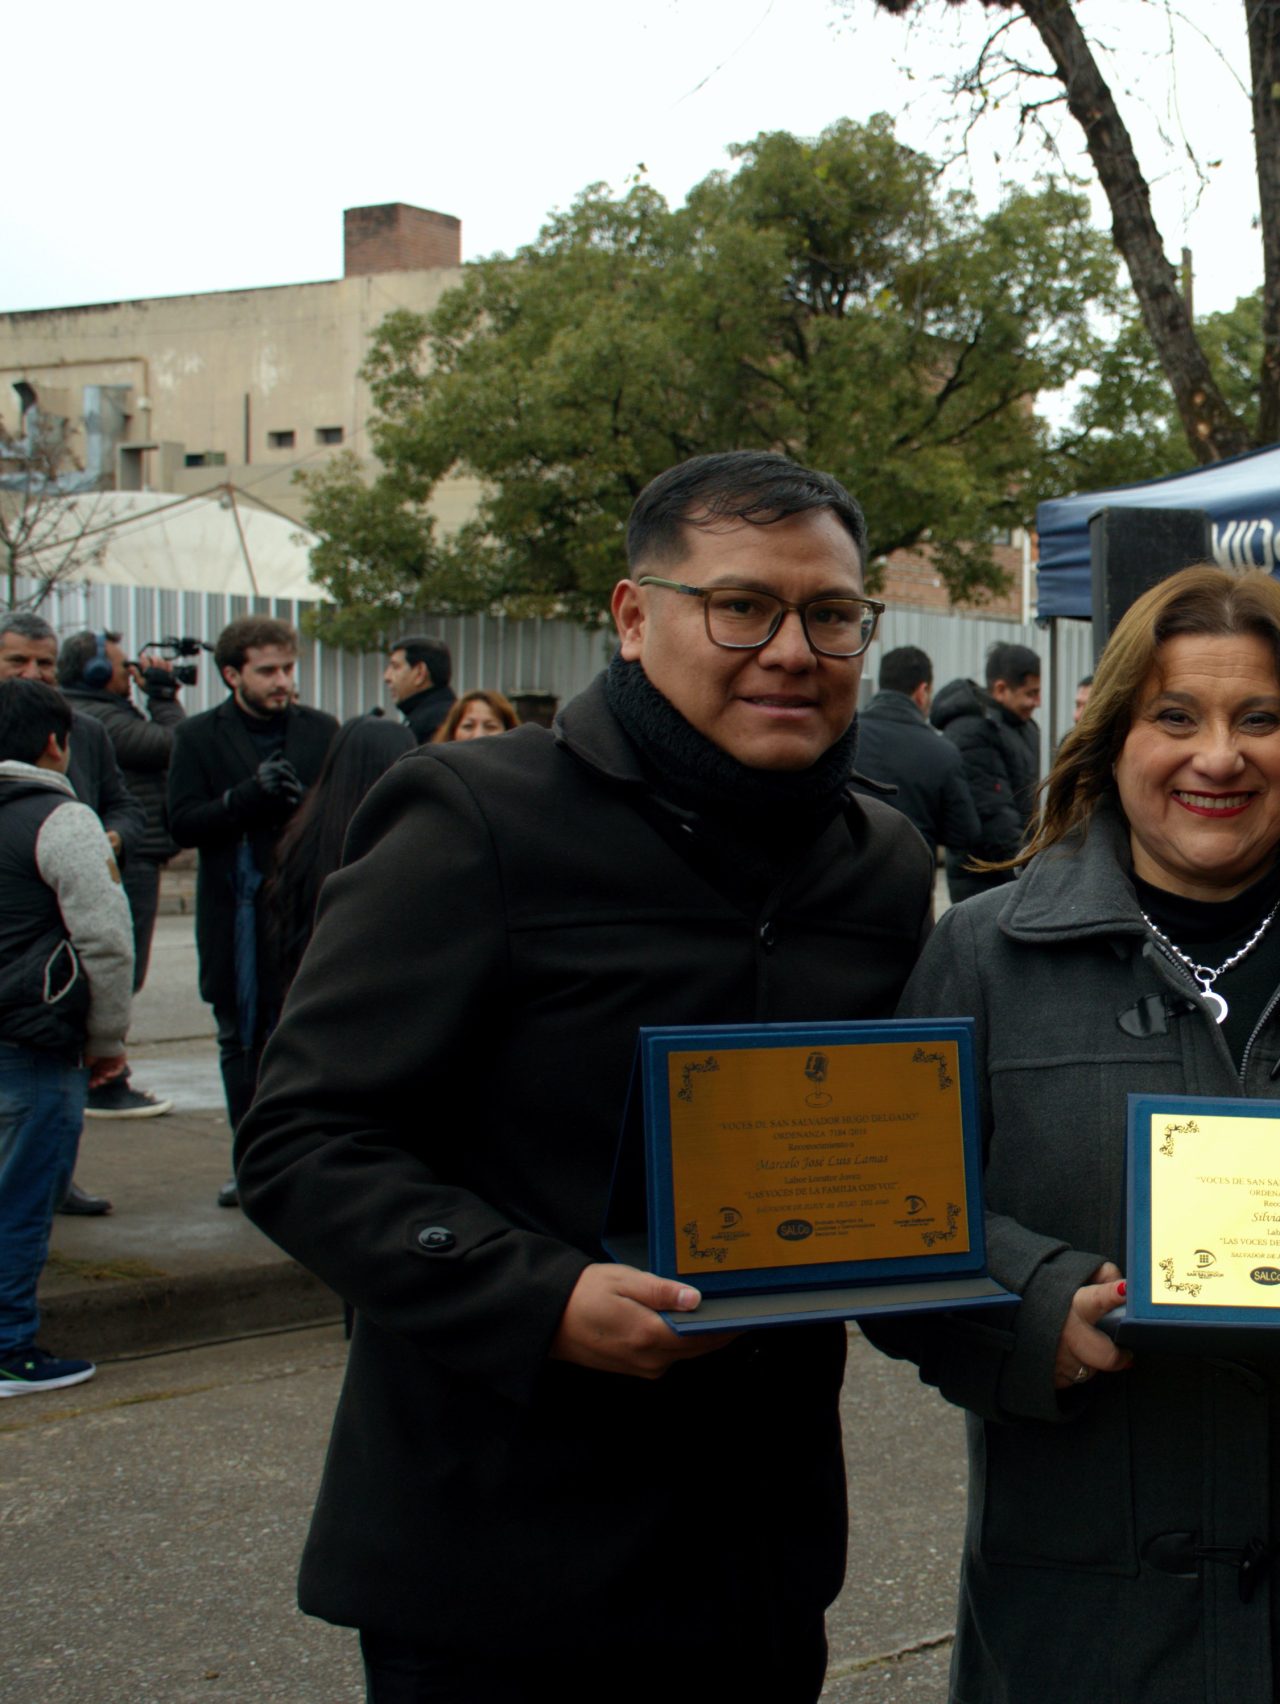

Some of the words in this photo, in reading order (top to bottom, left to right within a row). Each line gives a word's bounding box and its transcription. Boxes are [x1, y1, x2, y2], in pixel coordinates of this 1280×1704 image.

[1232, 1177, 1244, 1185] DE
[1246, 1177, 1264, 1185] SAN
[1251, 1211, 1280, 1222] Silvia
